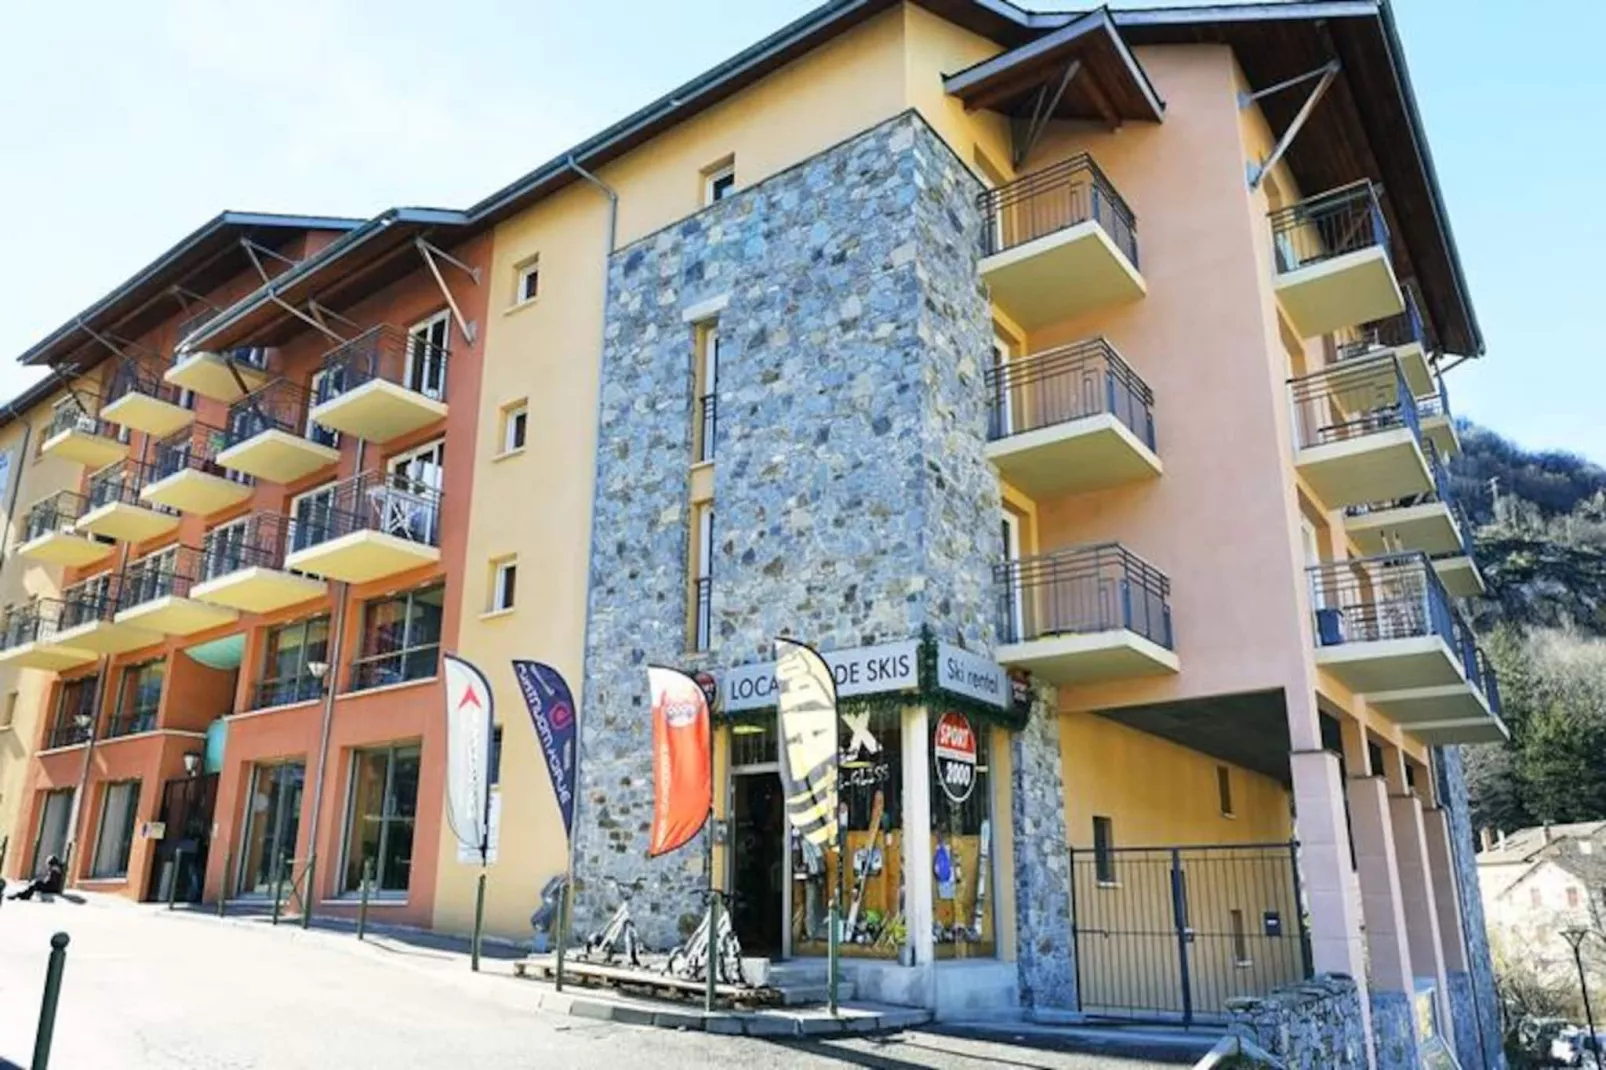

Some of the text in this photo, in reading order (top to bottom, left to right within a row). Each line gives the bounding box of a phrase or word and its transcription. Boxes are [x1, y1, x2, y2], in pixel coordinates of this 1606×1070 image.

[834, 662, 860, 685] DE
[867, 655, 911, 682] SKIS
[947, 658, 965, 683] Ski
[967, 669, 999, 694] rental
[940, 723, 969, 749] SPORT
[946, 761, 971, 786] 2000
